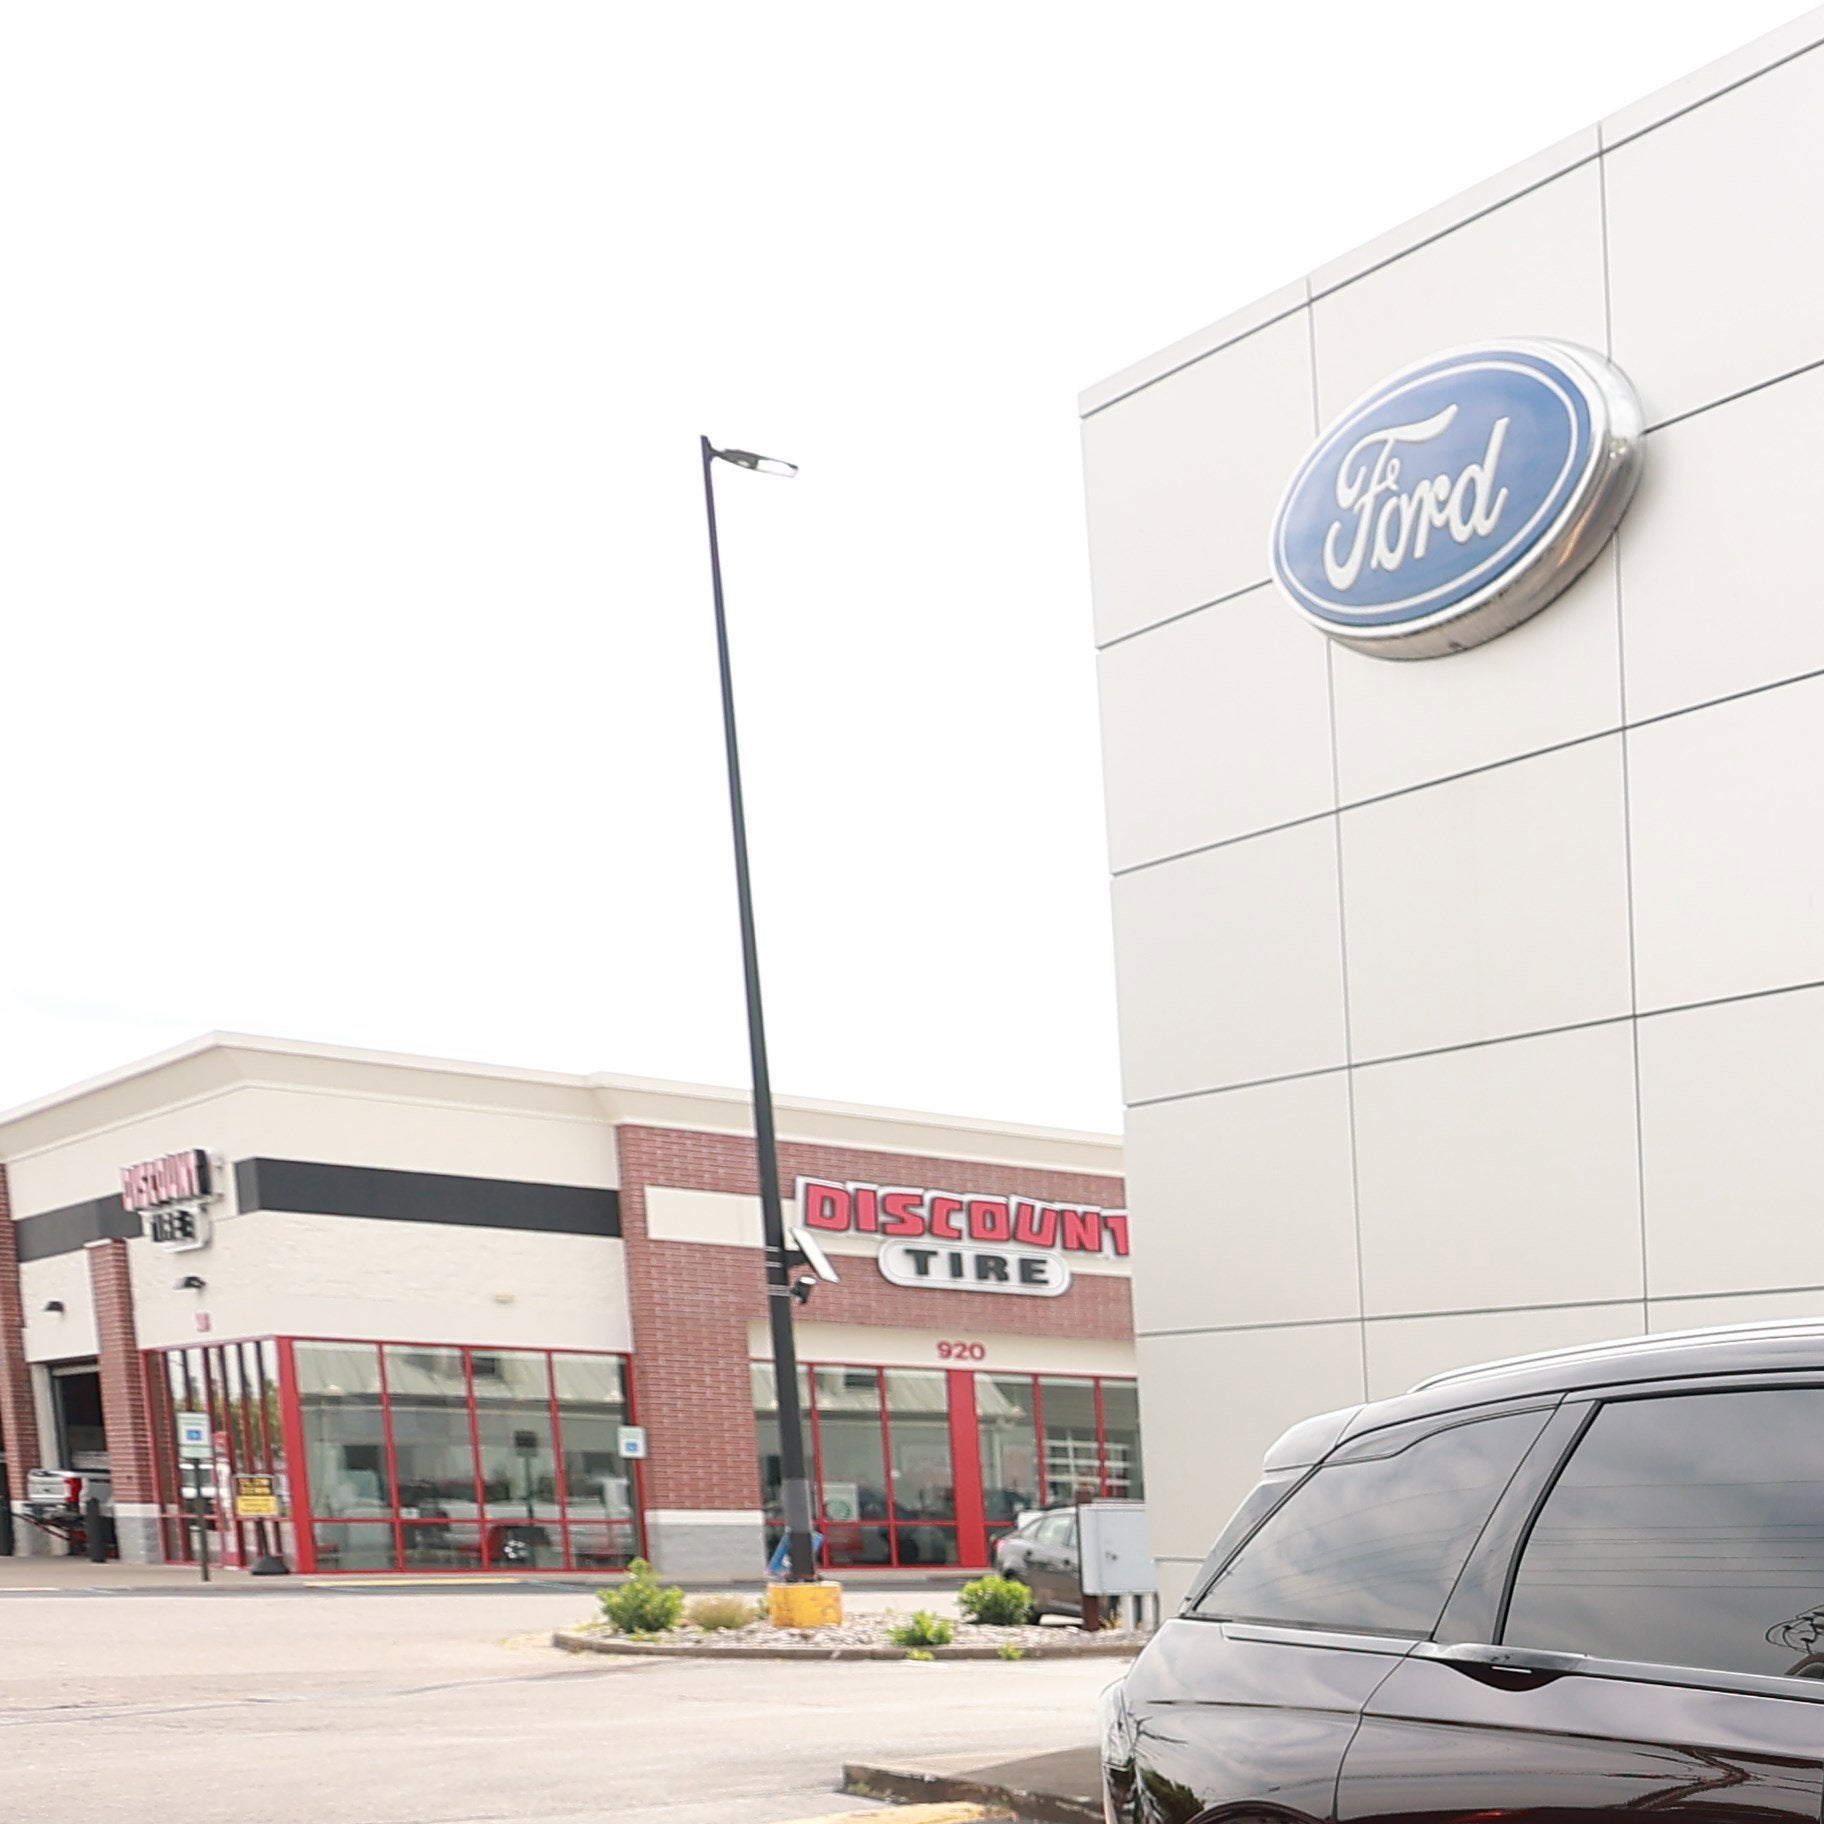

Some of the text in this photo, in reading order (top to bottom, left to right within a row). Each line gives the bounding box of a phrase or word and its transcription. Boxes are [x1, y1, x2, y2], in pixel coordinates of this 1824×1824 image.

[1322, 403, 1510, 592] Ford
[904, 1248, 1050, 1285] TIRE
[936, 1340, 986, 1361] 920
